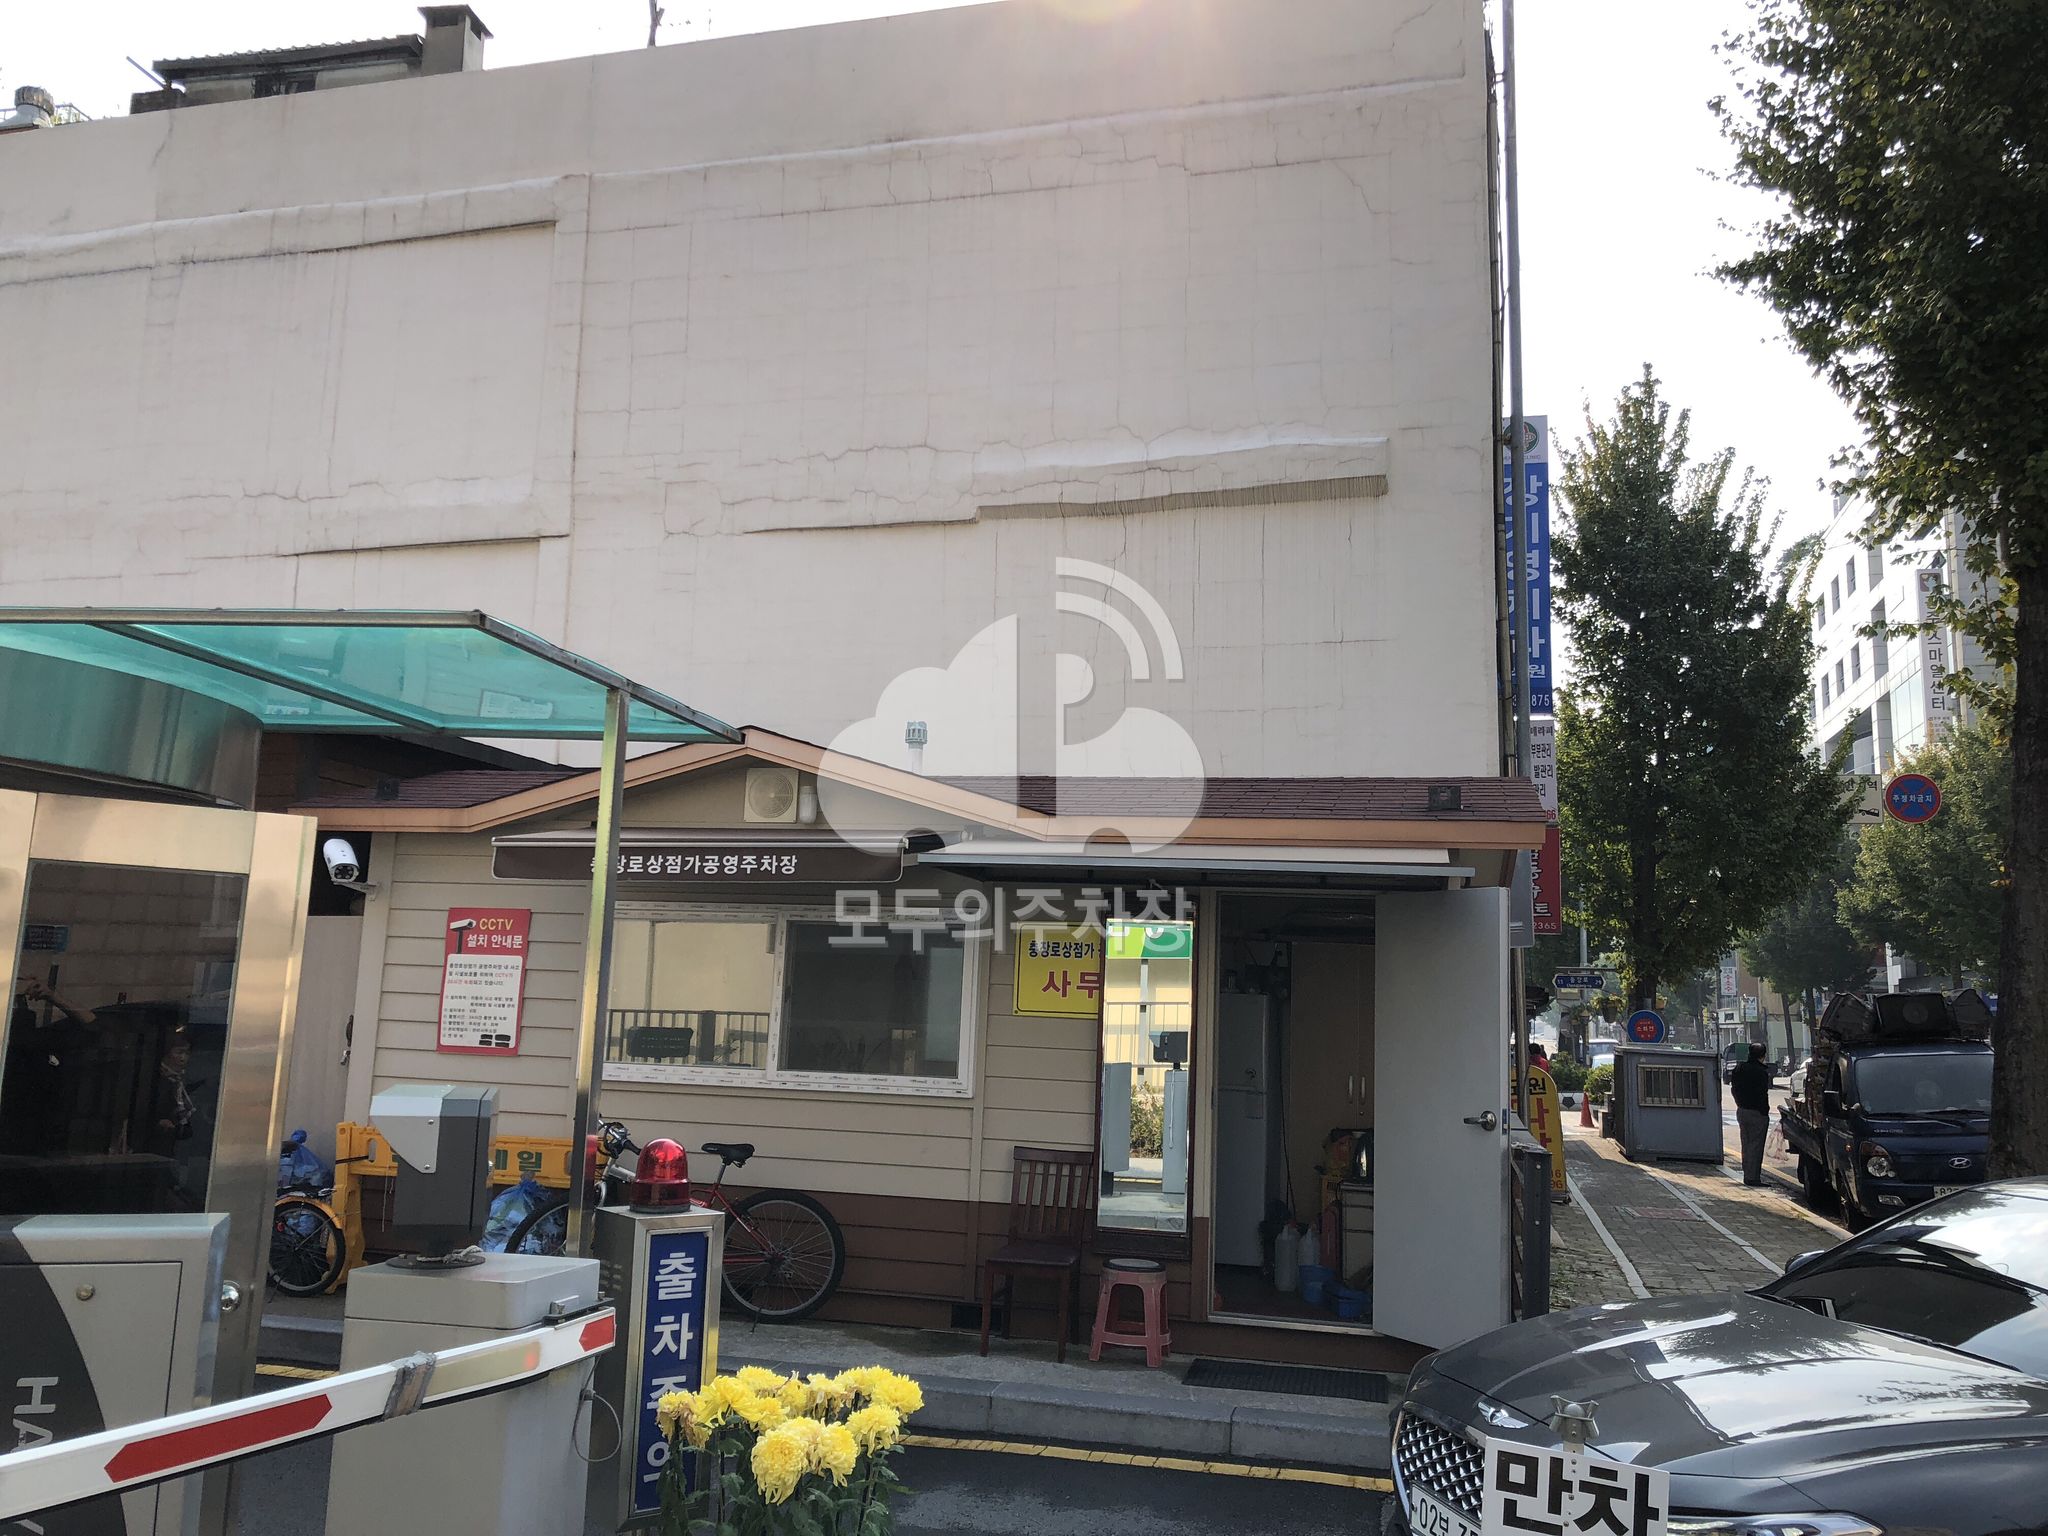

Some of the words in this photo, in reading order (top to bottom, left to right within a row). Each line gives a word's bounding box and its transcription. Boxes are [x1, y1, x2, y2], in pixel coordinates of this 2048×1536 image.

[1892, 794, 1933, 803] 주정차금지
[479, 918, 514, 931] CCTV
[467, 933, 488, 948] 설치
[491, 934, 523, 949] 안내문
[1495, 1449, 1660, 1536] 만차
